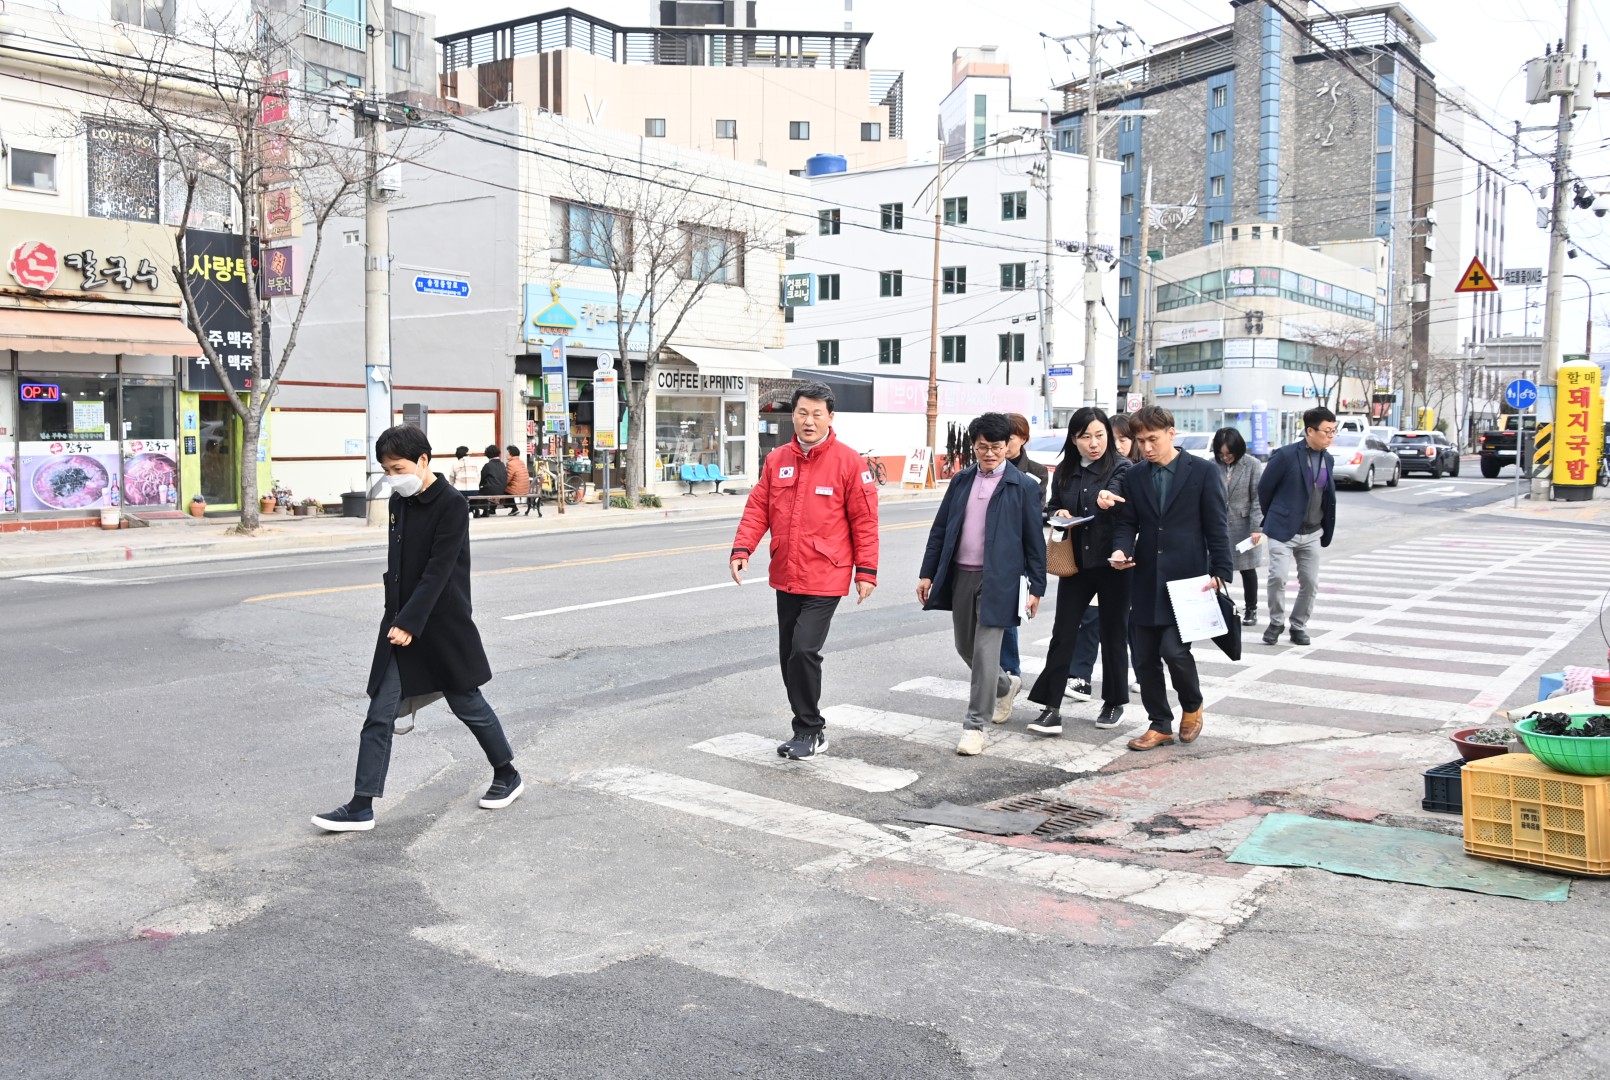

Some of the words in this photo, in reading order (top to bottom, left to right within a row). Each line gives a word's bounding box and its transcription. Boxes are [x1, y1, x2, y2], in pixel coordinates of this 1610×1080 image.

[138, 205, 156, 219] 2F
[64, 249, 158, 291] 칼국수
[267, 276, 292, 292] 부동산
[786, 289, 810, 302] 크리닝
[658, 372, 698, 389] COFFEE
[709, 375, 744, 390] PRINTS
[1567, 371, 1596, 385] 할매
[23, 386, 57, 399] OPN
[1130, 401, 1139, 410] 30
[1565, 386, 1591, 481] 돼지국밥
[909, 448, 926, 478] 세탁
